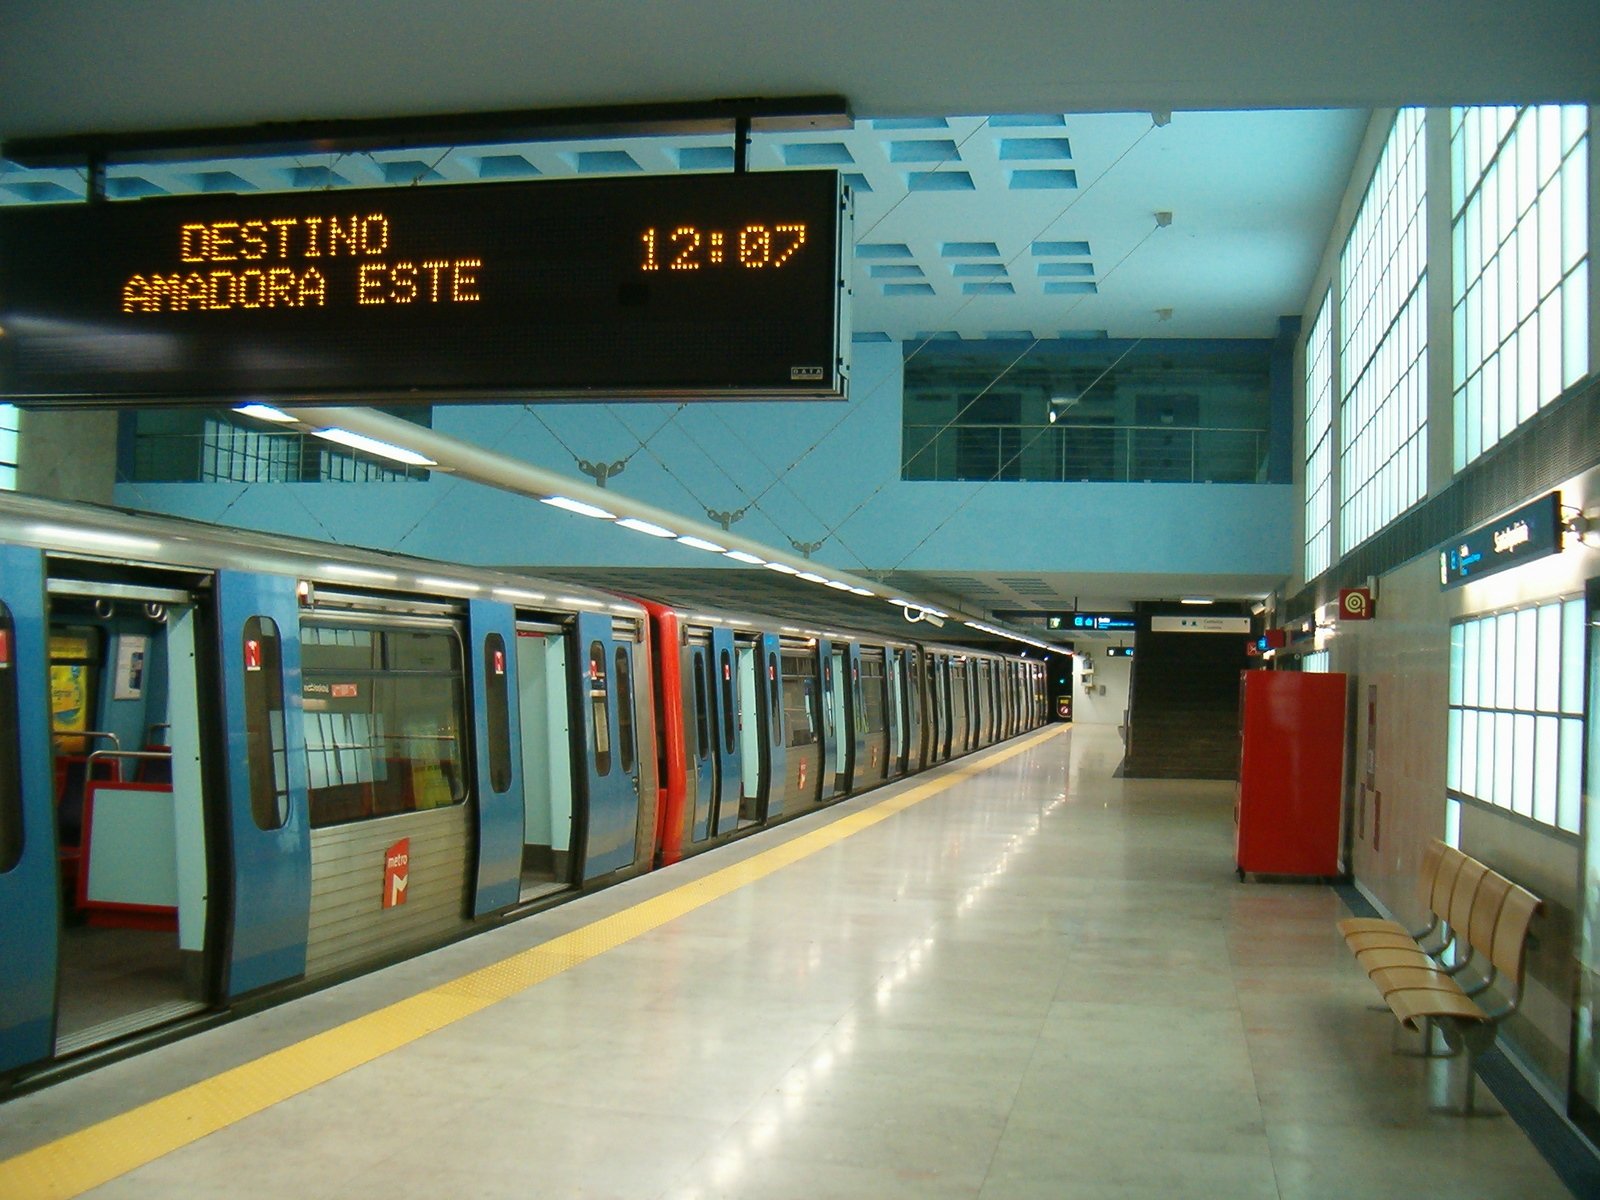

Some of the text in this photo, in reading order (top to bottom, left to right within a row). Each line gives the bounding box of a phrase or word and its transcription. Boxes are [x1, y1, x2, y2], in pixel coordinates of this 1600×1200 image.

[182, 213, 389, 262] DESTINO
[642, 224, 807, 270] 12:07
[122, 260, 482, 313] AMADORA ESTE
[388, 854, 408, 868] metro
